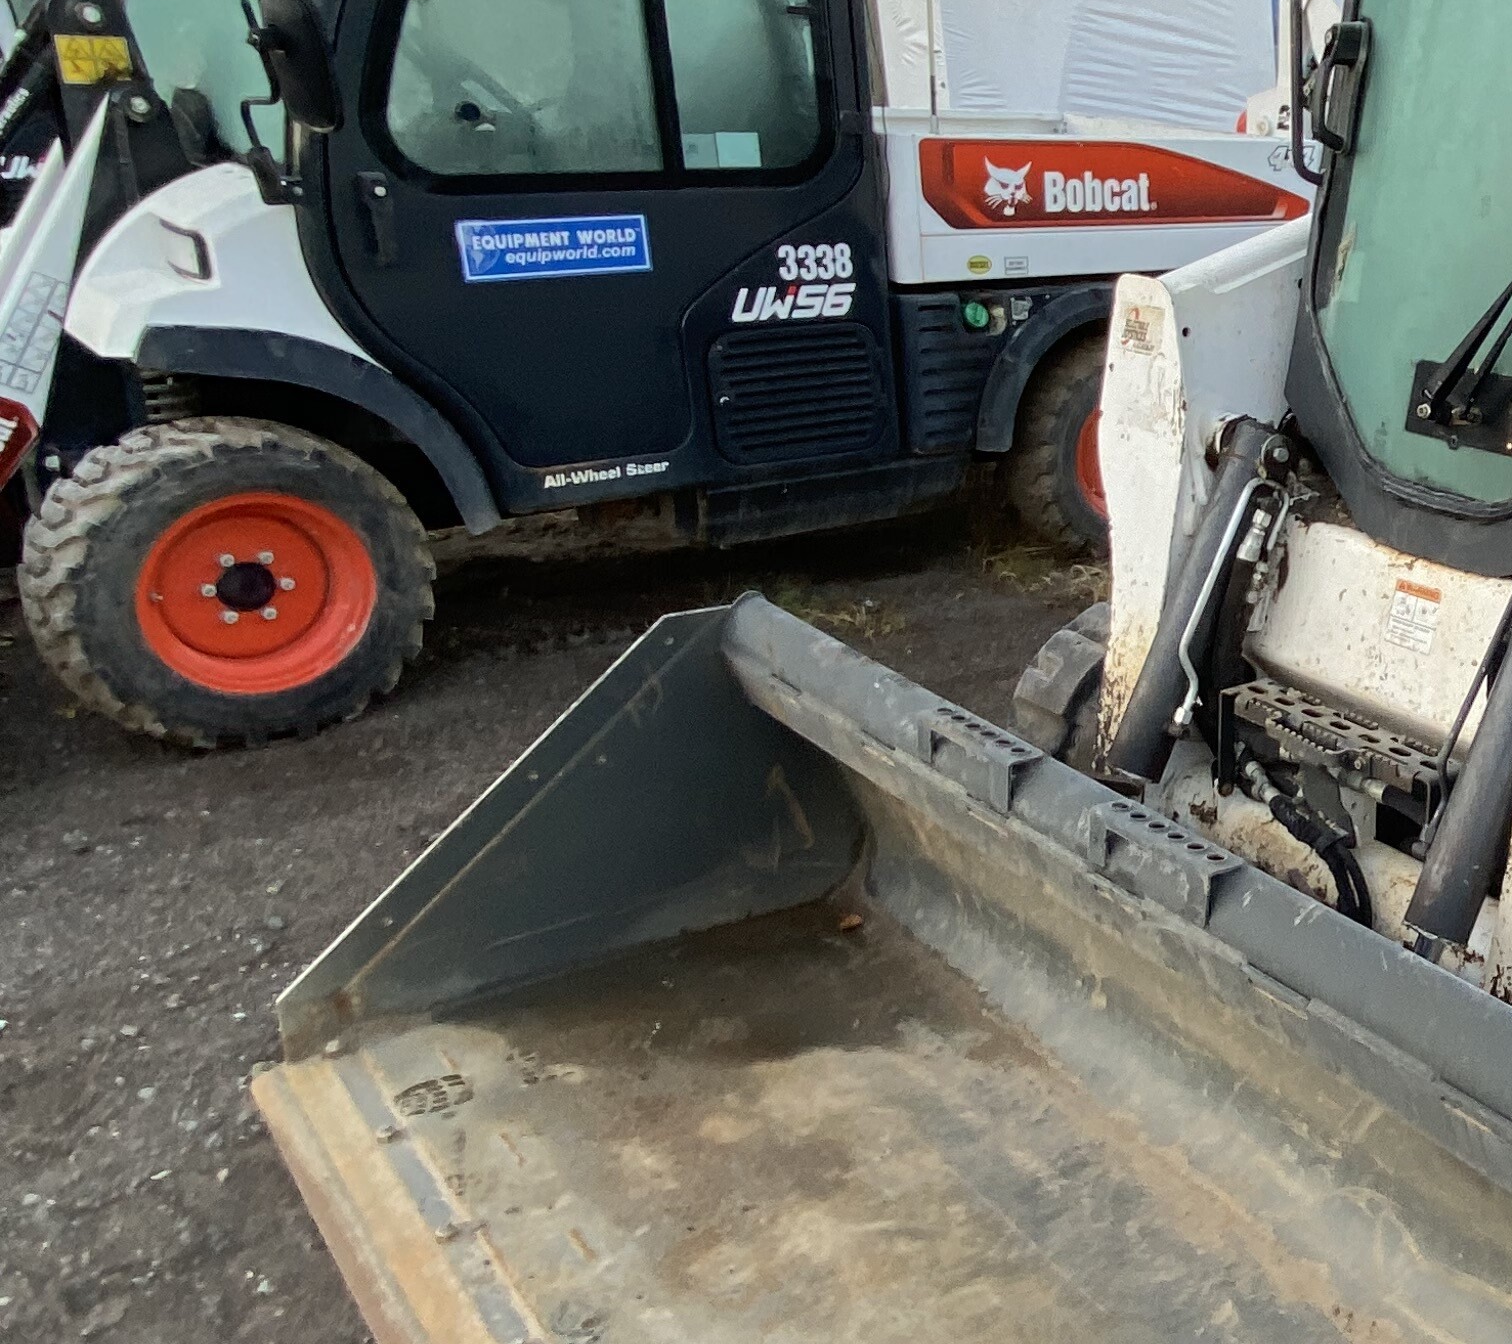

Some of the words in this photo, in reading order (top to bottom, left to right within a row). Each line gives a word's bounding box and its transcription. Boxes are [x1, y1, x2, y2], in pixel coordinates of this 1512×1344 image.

[1043, 170, 1151, 213] Bobcat
[471, 231, 570, 251] EQUIPMENT
[577, 227, 638, 245] WORLD
[505, 245, 636, 266] equipworld.com
[778, 242, 854, 281] 3338
[731, 282, 857, 323] UW56
[543, 466, 621, 489] All-Wheel
[626, 461, 669, 477] Steer
